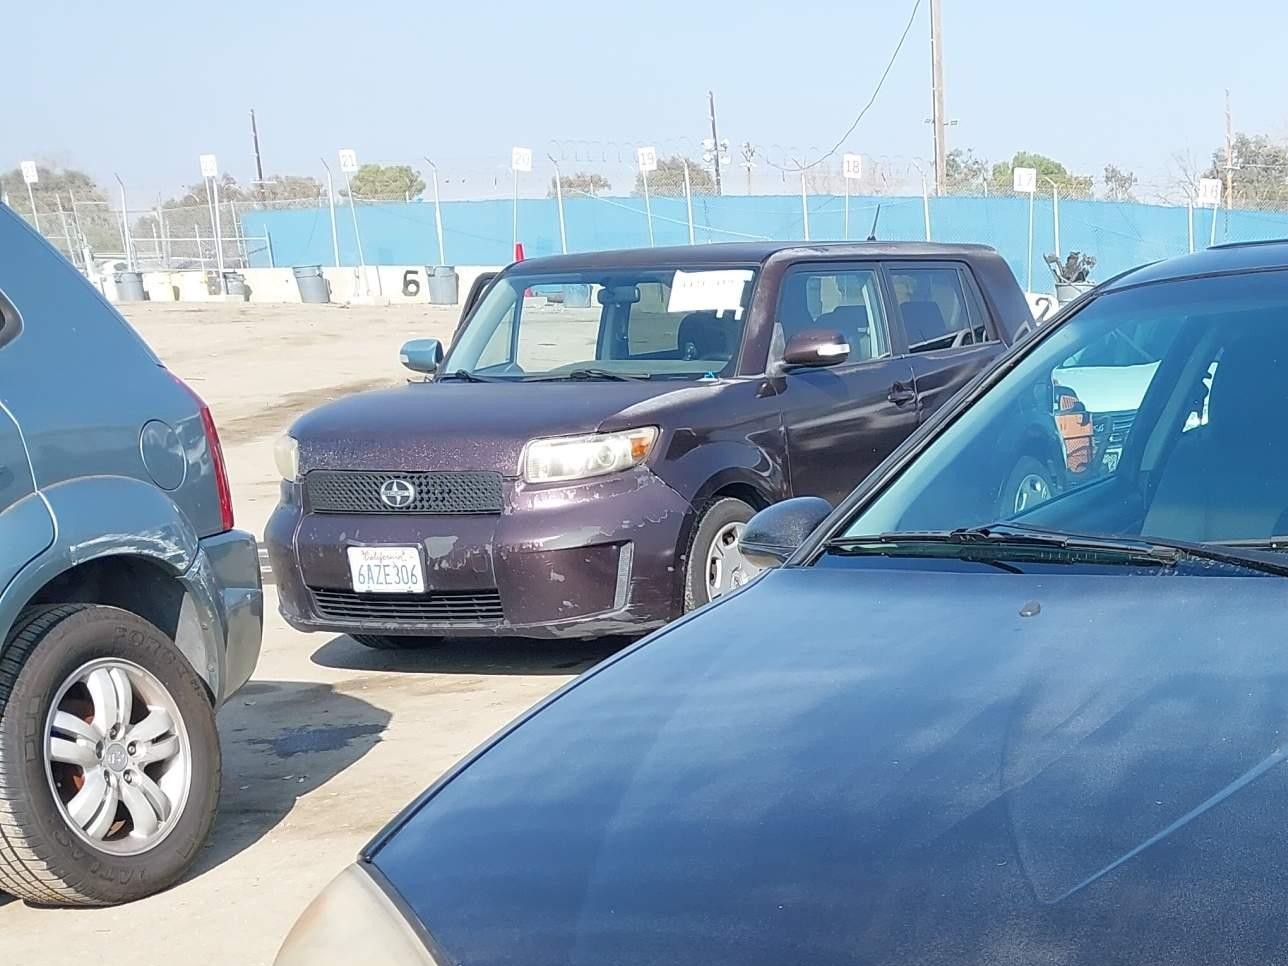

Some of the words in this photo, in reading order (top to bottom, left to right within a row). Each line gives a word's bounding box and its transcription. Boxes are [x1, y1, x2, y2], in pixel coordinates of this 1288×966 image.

[342, 153, 355, 168] 21
[640, 151, 654, 168] 19
[846, 160, 860, 174] 18
[402, 269, 420, 297] 6
[358, 564, 418, 585] 6AZE306
